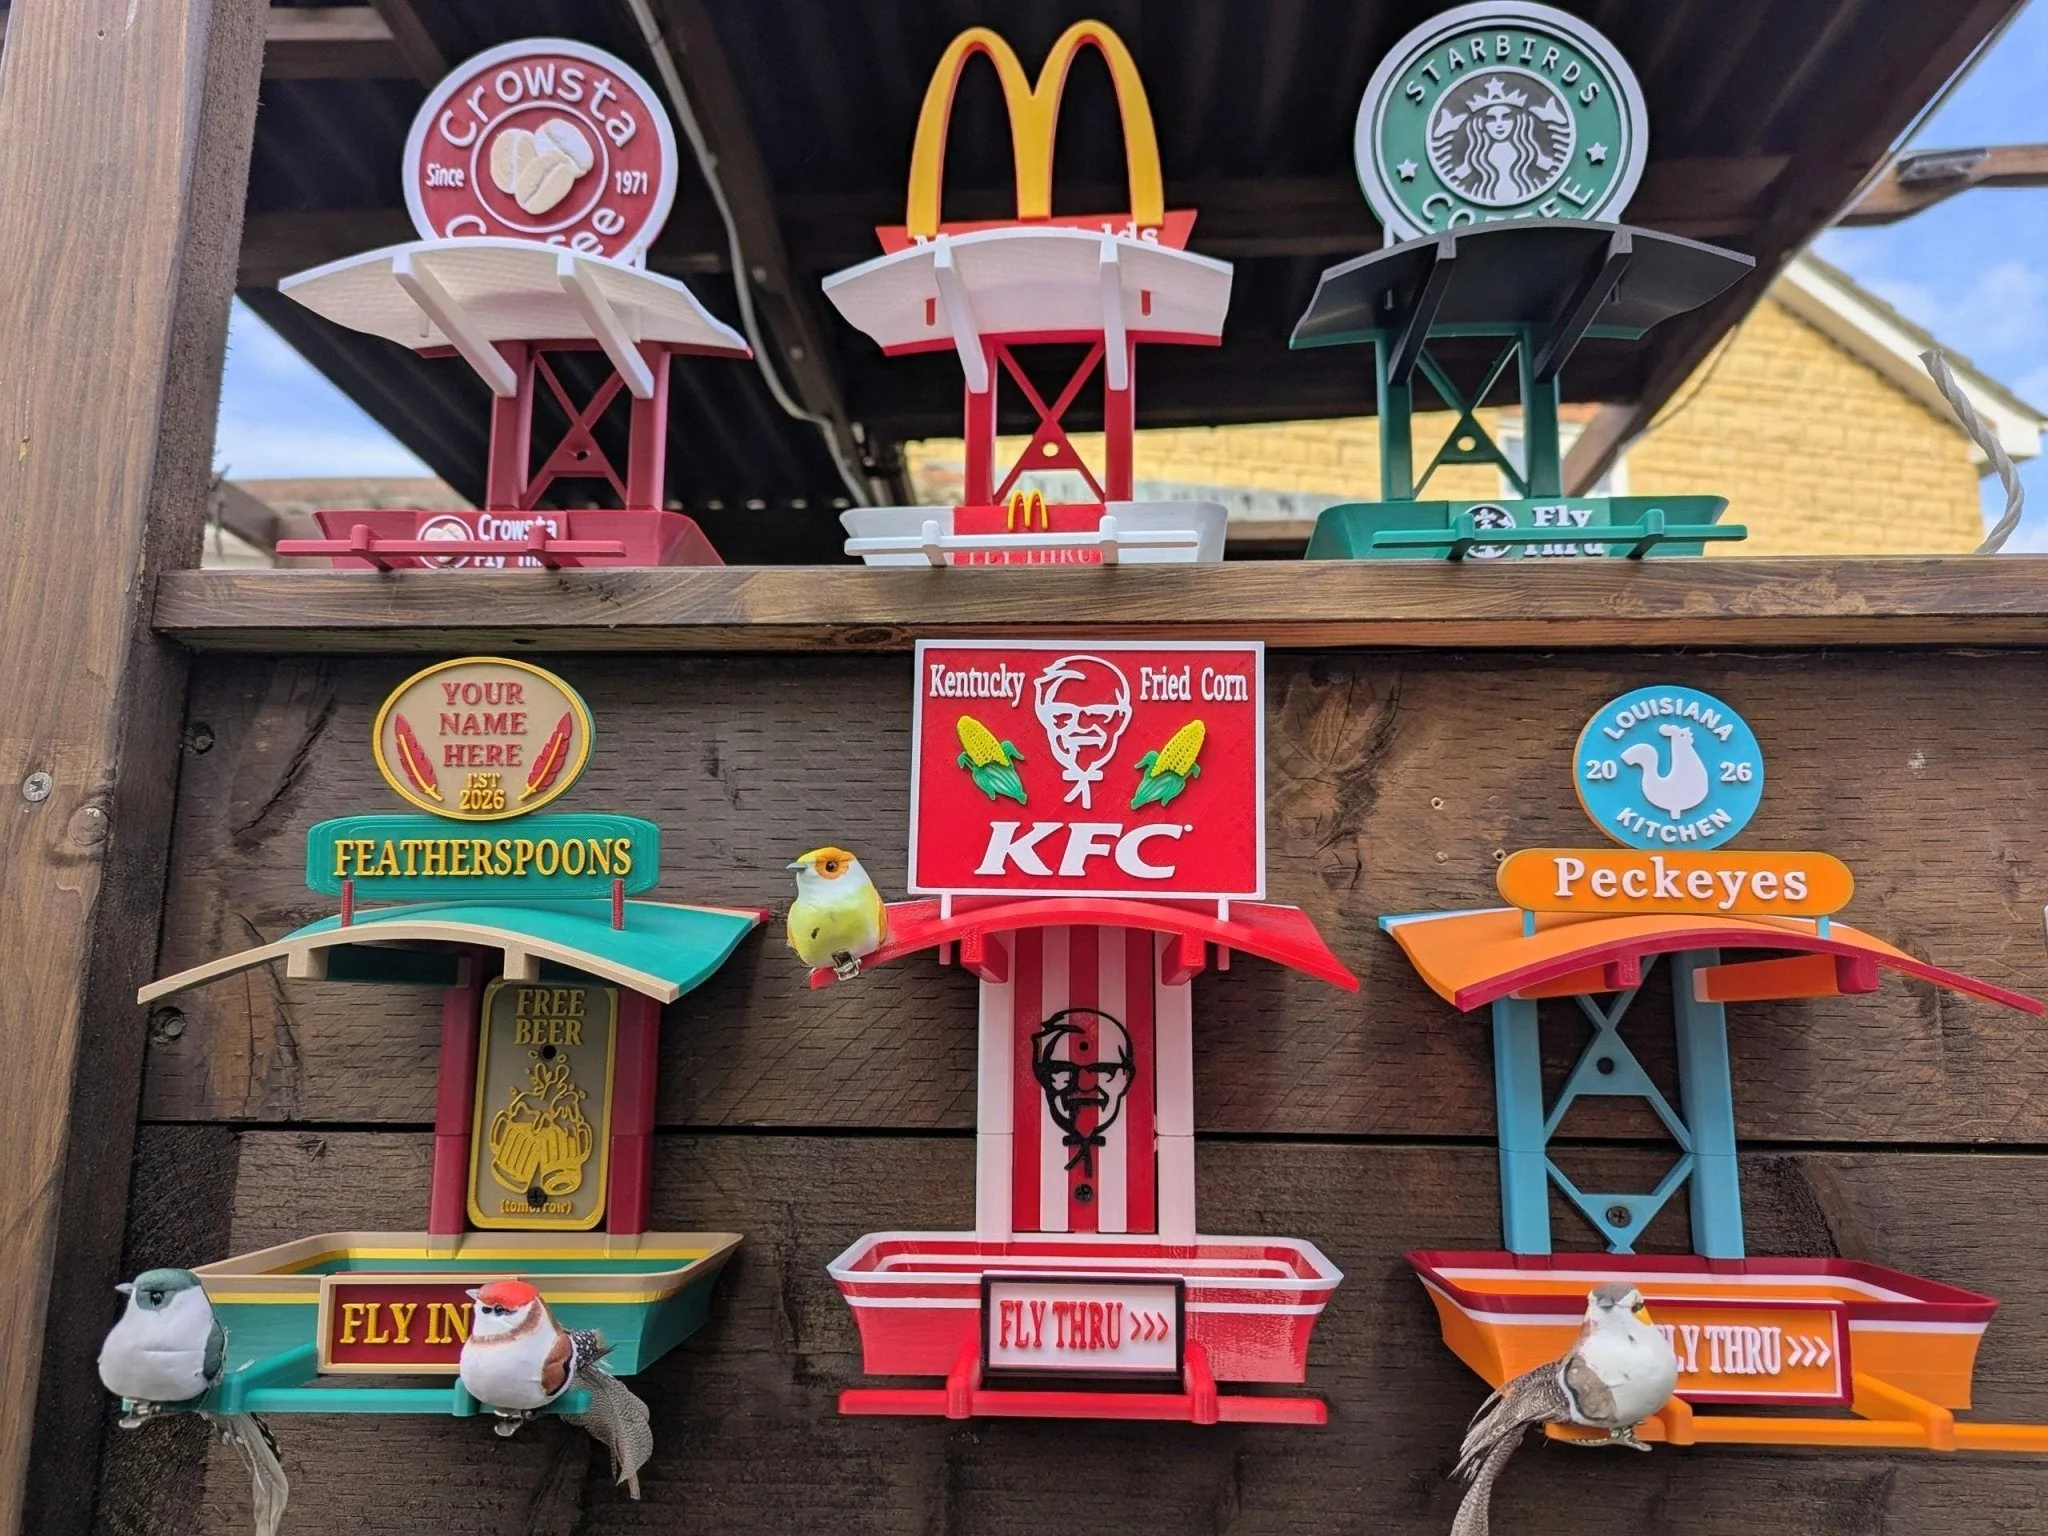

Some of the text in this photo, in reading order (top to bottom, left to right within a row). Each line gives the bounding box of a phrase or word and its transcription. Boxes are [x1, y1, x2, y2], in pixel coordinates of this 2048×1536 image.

[1405, 35, 1600, 104] STARBIRDS
[439, 62, 637, 148] Crowsta
[426, 163, 464, 188] Since
[615, 170, 648, 195] 1971
[441, 682, 524, 706] YOUR
[929, 663, 1249, 708] Kentucky Fried Corn
[439, 712, 528, 736] NAME
[1602, 697, 1734, 742] LOUISIANA
[443, 743, 523, 768] HERE
[1586, 759, 1617, 780] 20
[1720, 761, 1753, 782] 26
[467, 773, 501, 788] EST
[459, 789, 505, 810] 2026
[1615, 806, 1733, 843] KITCHEN
[334, 838, 632, 877] FEATHERSPOONS
[974, 821, 1184, 879] KFC
[1553, 856, 1808, 910] Peckeyes
[516, 988, 587, 1017] FREE
[514, 1019, 582, 1045] BEER
[339, 1302, 473, 1344] FLY IN
[999, 1299, 1123, 1349] FLY THRU
[1655, 1324, 1782, 1375] LY THRU
